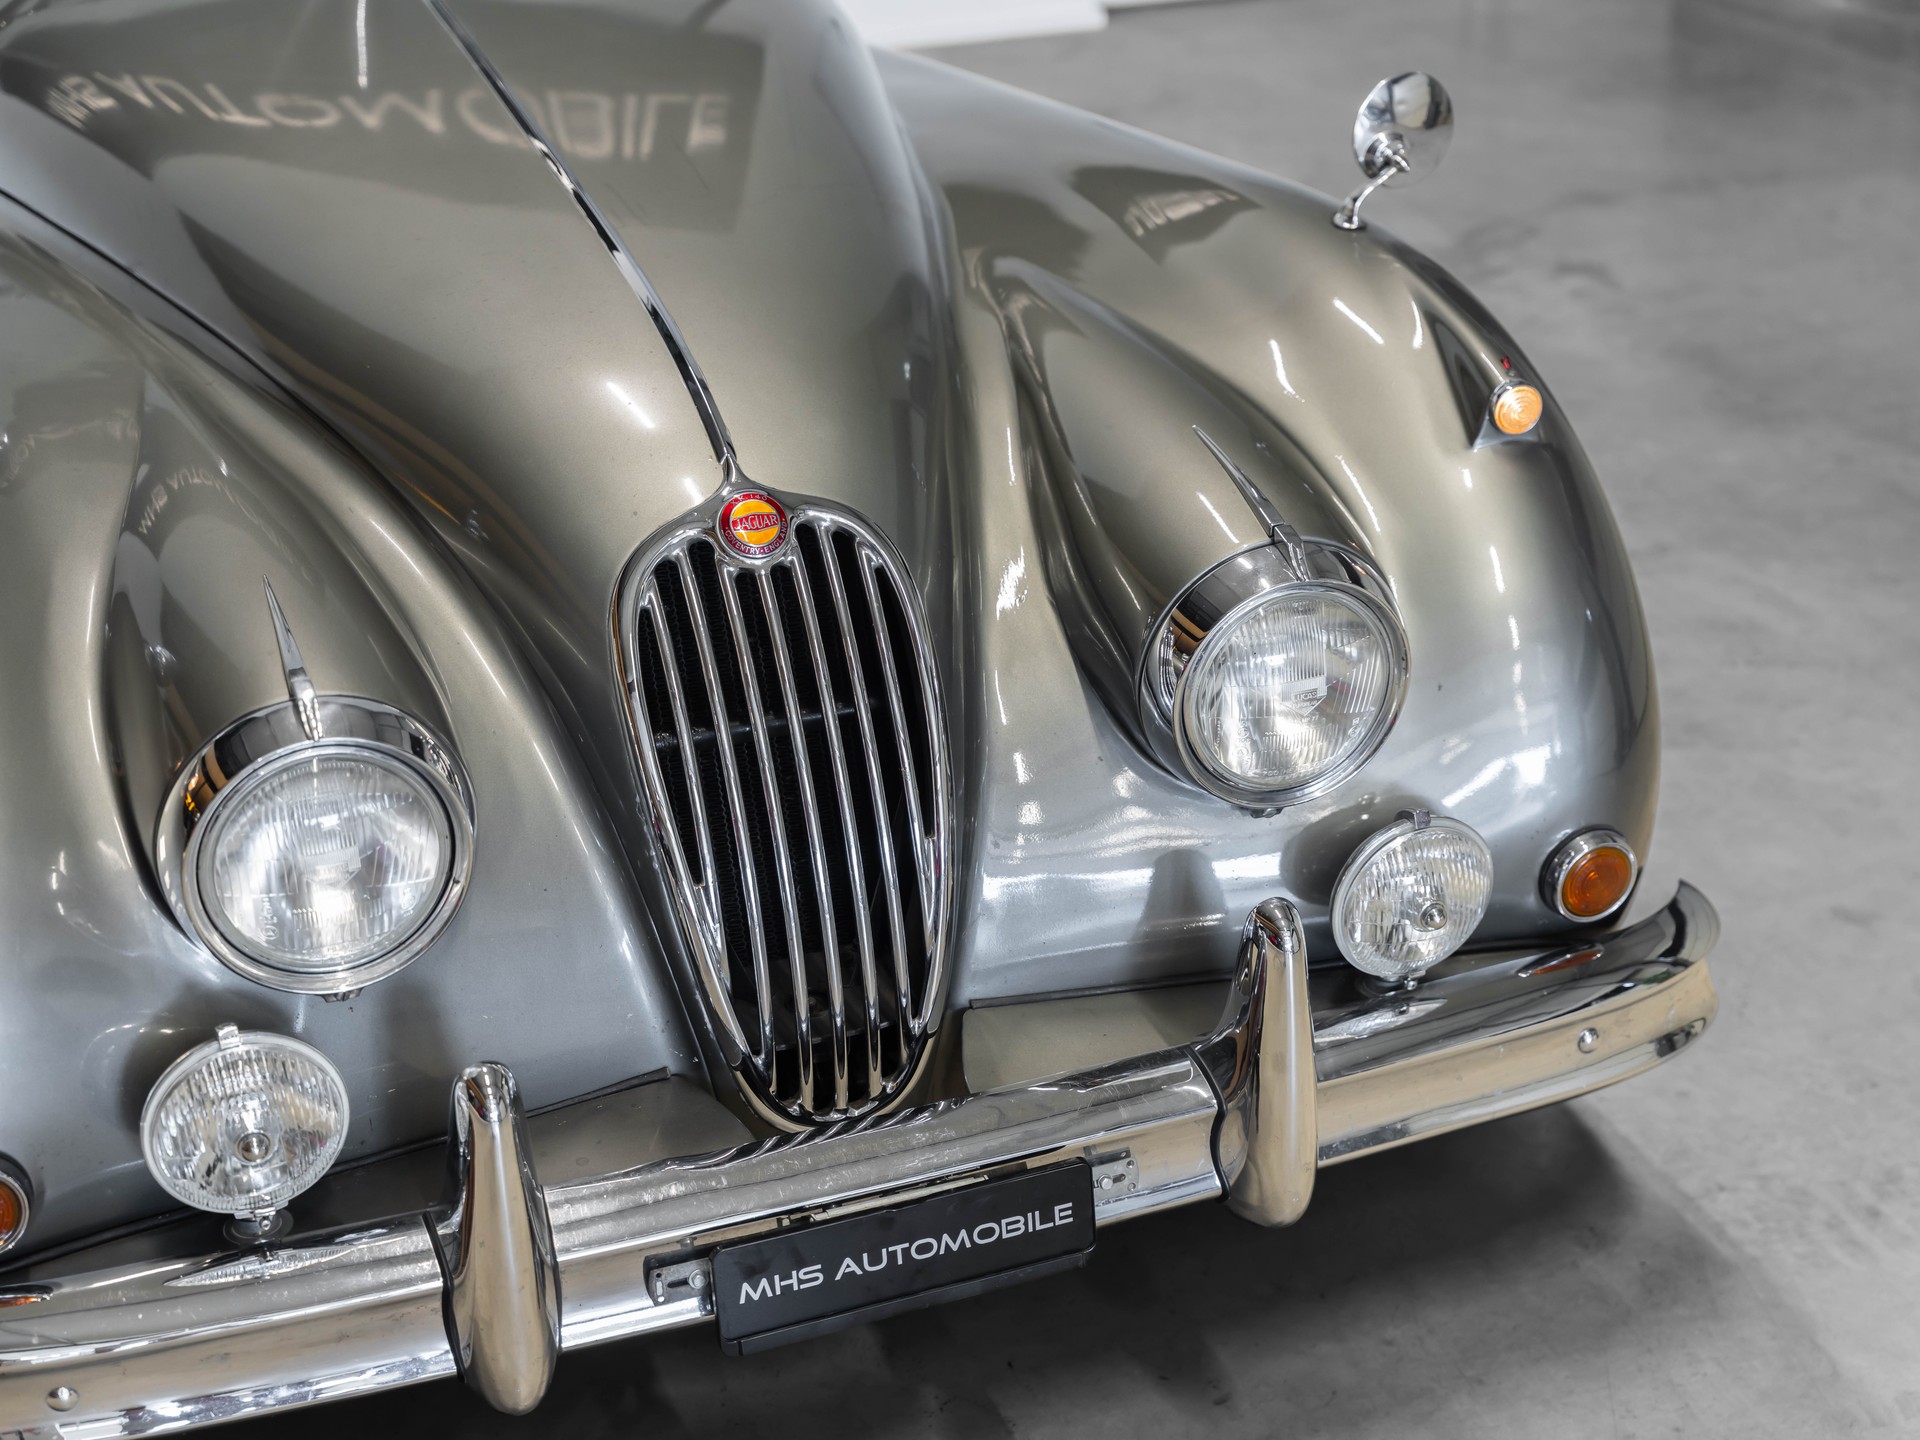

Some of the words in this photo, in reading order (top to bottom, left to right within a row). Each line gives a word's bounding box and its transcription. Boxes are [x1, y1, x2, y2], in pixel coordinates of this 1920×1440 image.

[725, 529, 760, 555] COVENTRY
[764, 521, 788, 553] ENGLAND
[734, 514, 778, 531] JAGUAR
[739, 1264, 824, 1305] MHS
[834, 1202, 1074, 1281] AUTOMOBILE
